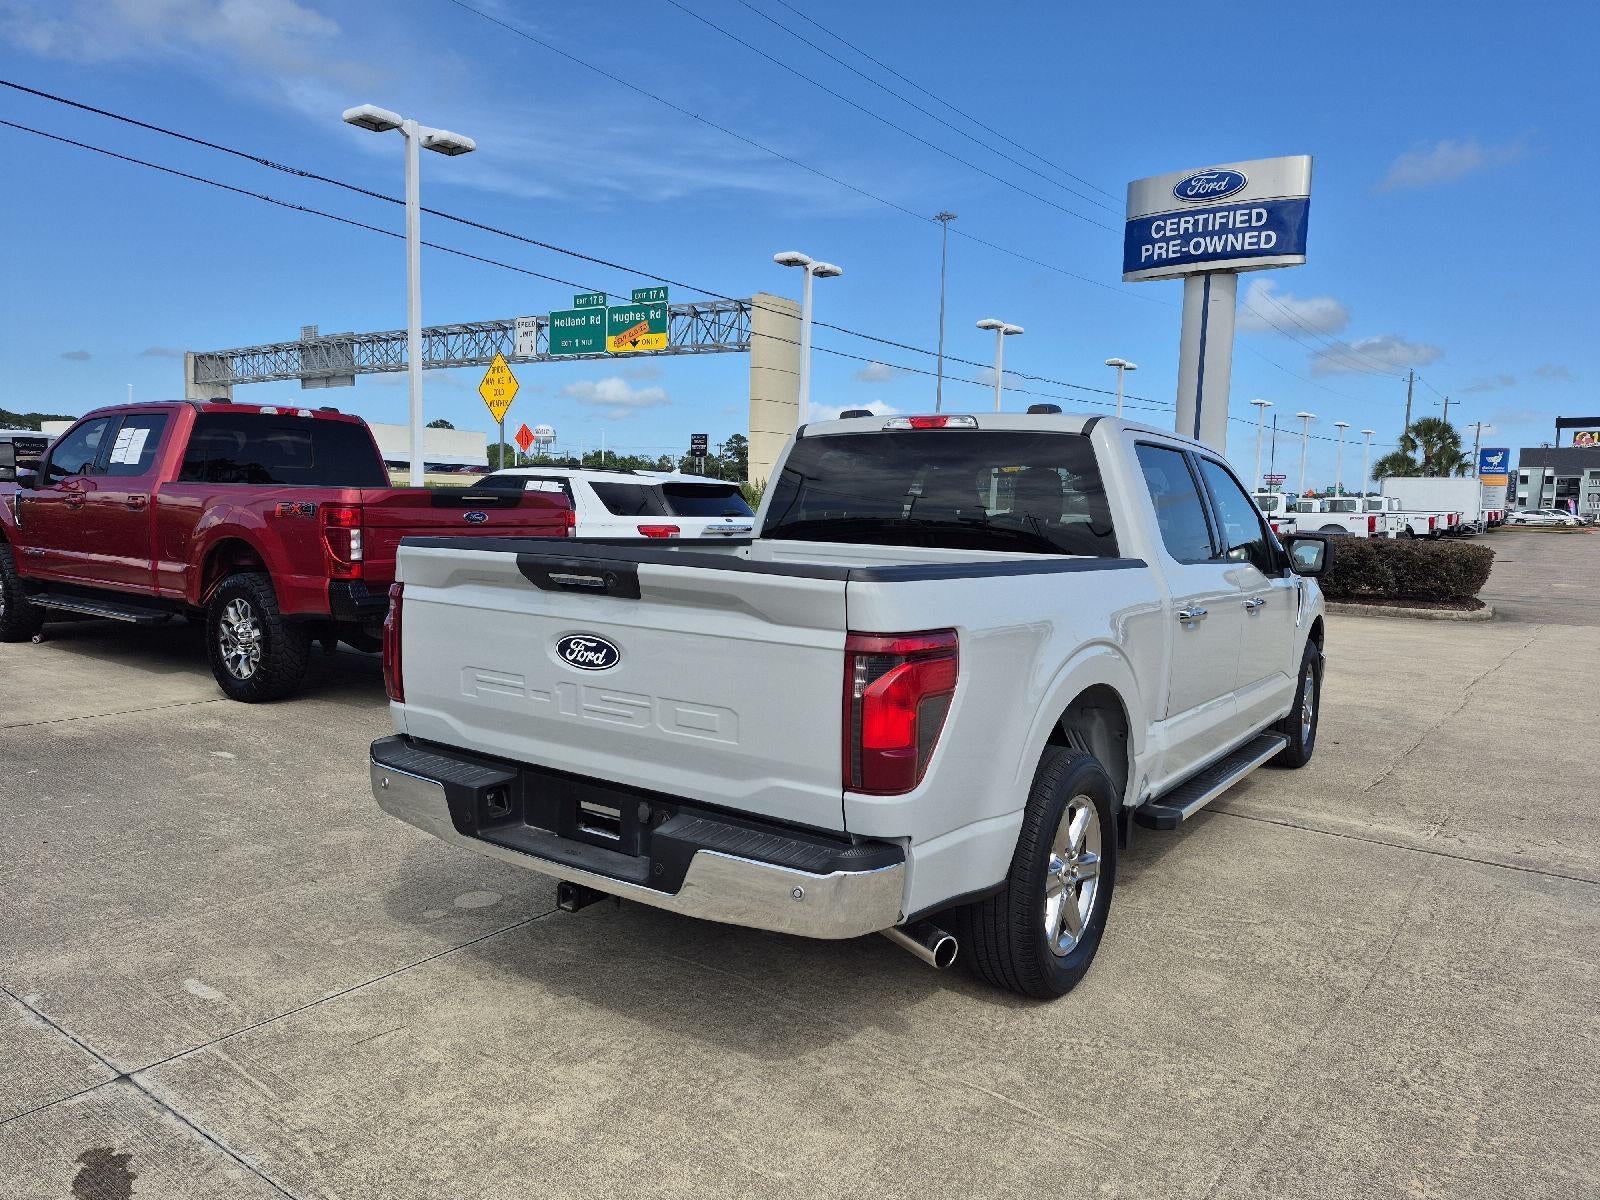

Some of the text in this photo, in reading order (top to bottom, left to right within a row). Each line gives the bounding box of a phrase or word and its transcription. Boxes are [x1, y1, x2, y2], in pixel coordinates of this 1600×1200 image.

[1186, 173, 1230, 196] Ford
[1150, 208, 1268, 239] CERTIFIED
[1141, 230, 1277, 262] PRE-OWNED
[517, 320, 536, 329] SPEED
[554, 314, 601, 327] Holland Rd
[612, 309, 661, 324] Hughes Rd
[519, 330, 534, 338] LIMIT
[641, 337, 660, 346] ONLY
[575, 338, 579, 347] 1
[275, 501, 315, 518] FX4
[565, 637, 607, 665] Ford
[461, 665, 740, 745] F-150
